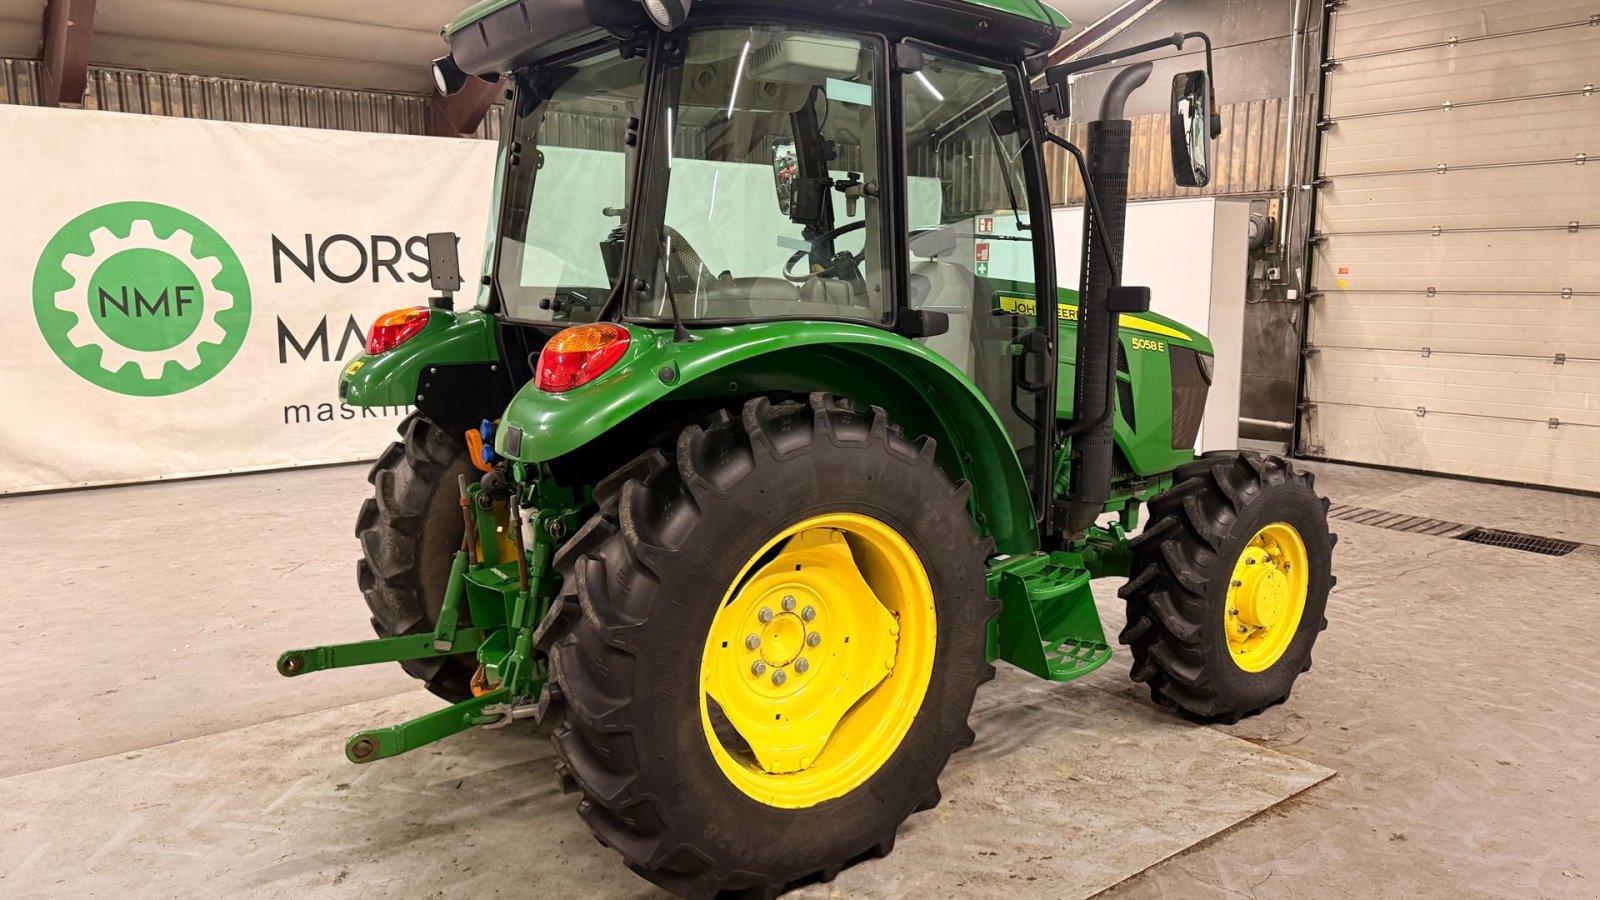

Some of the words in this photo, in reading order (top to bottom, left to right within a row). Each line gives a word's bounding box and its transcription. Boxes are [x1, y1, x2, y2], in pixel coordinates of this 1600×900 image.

[271, 233, 465, 284] NORS
[98, 285, 195, 318] NMF
[1011, 300, 1036, 314] JOH
